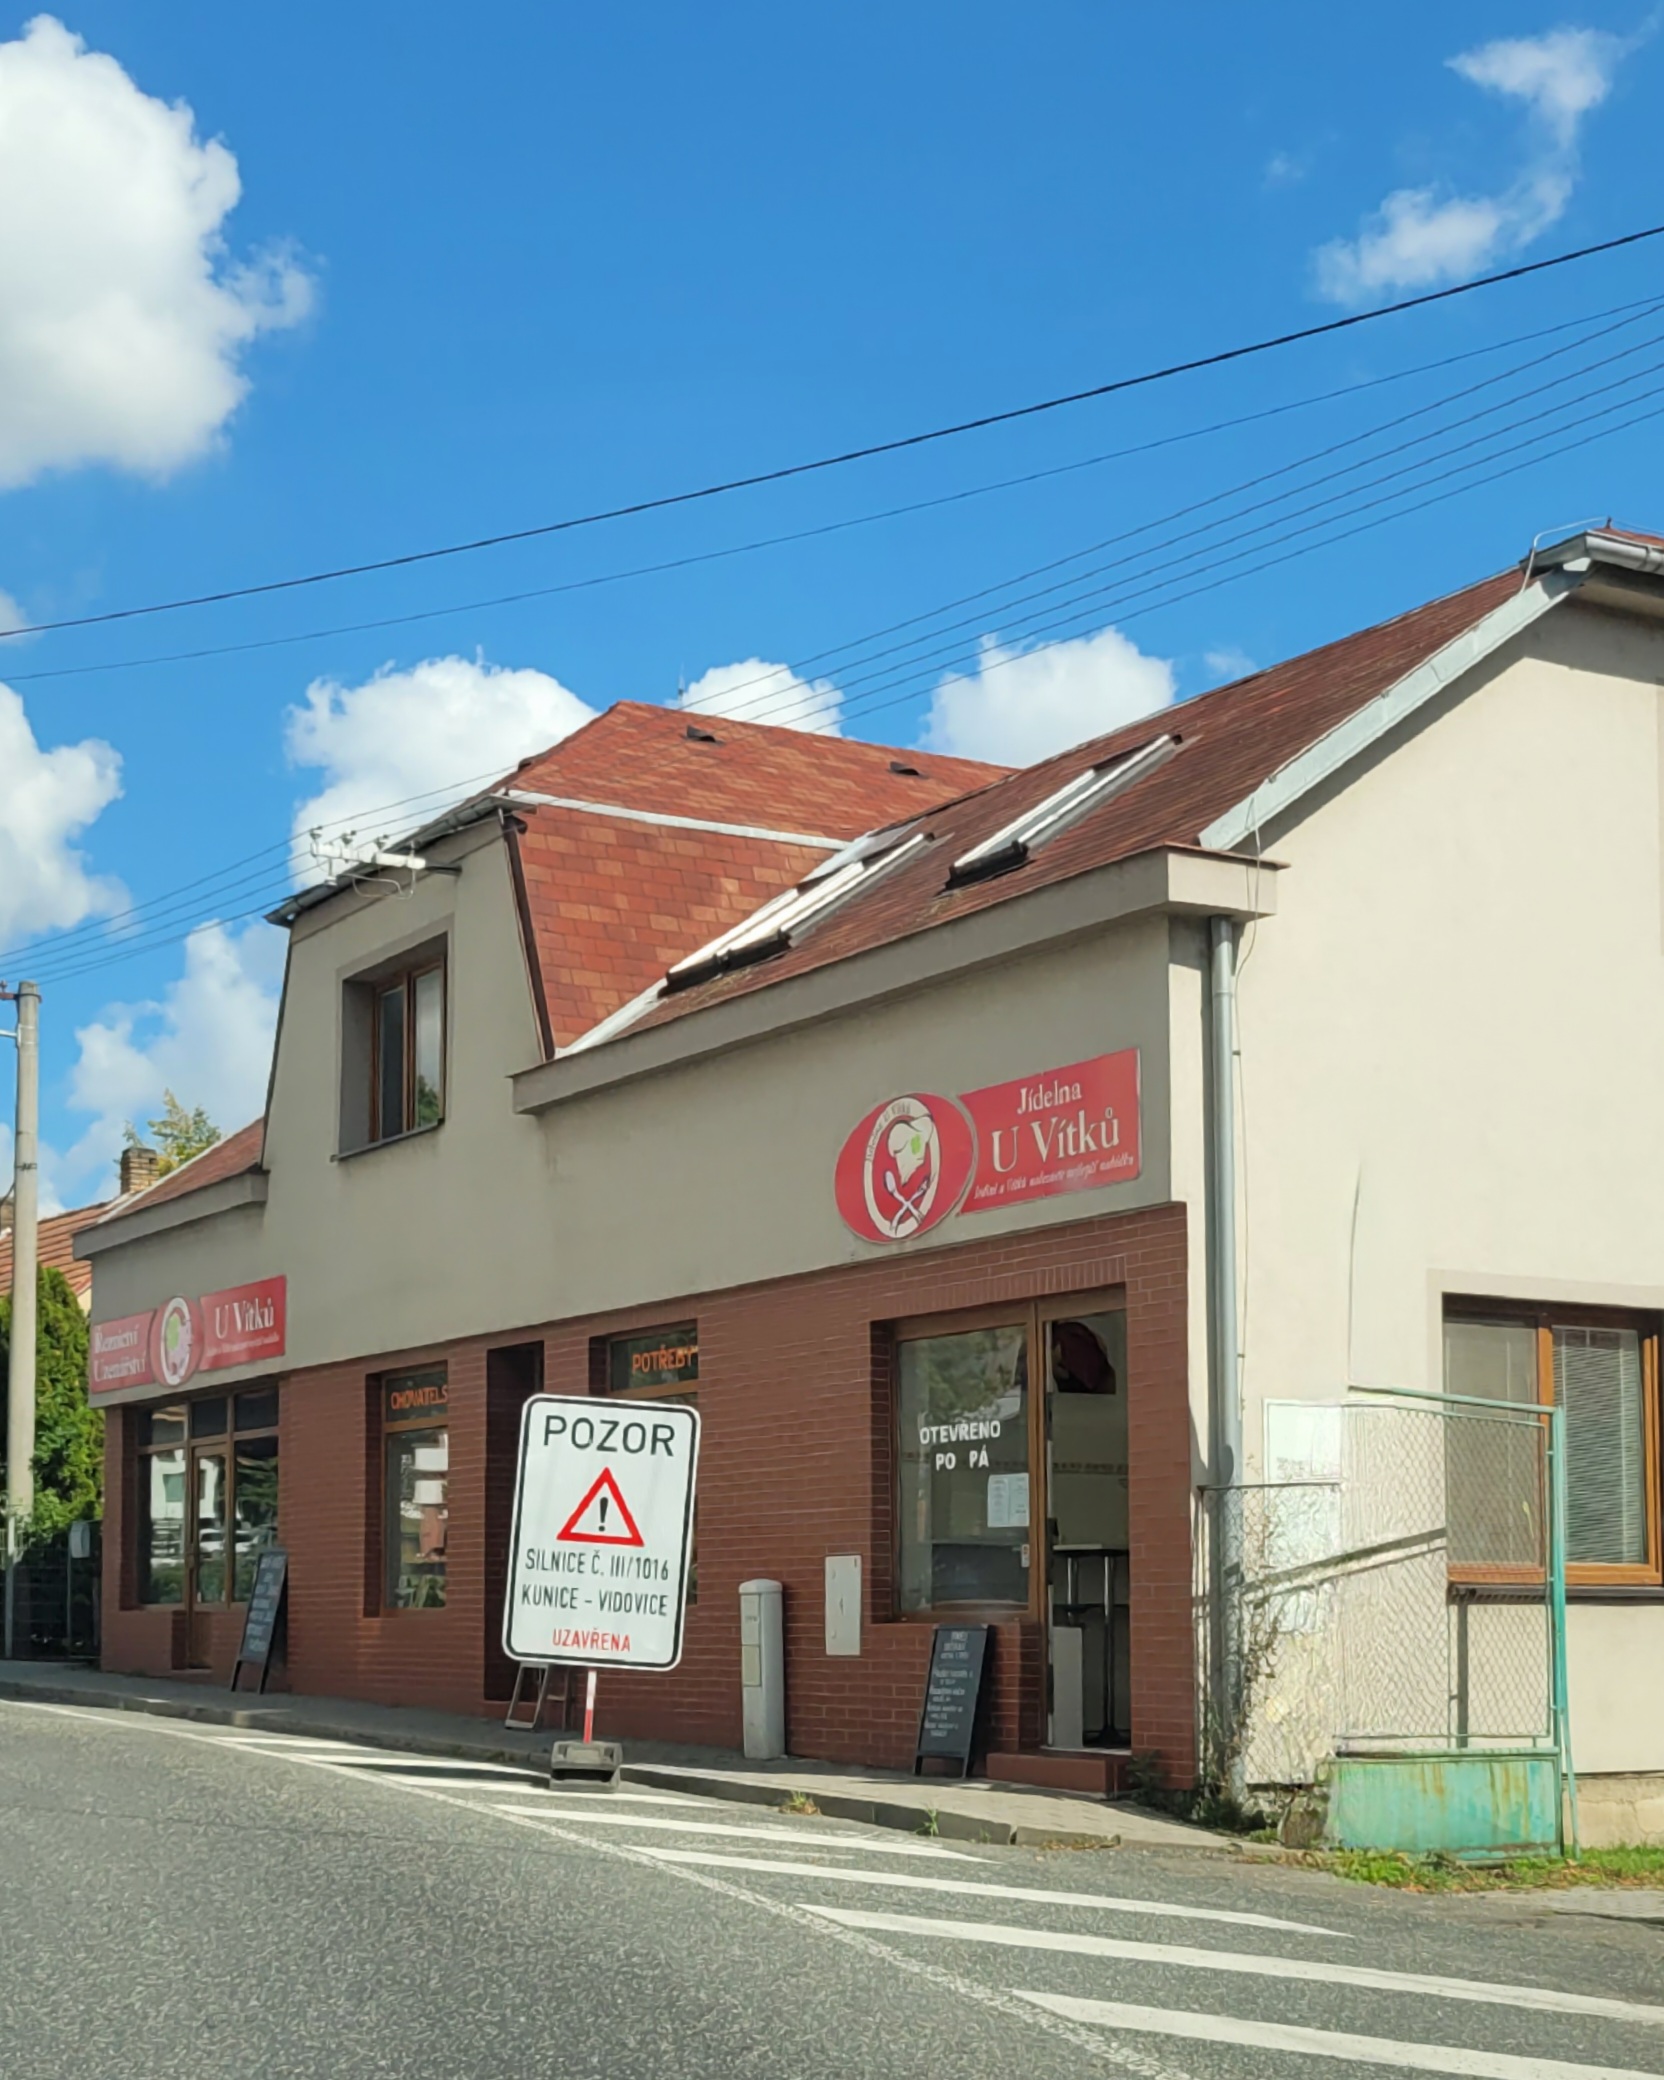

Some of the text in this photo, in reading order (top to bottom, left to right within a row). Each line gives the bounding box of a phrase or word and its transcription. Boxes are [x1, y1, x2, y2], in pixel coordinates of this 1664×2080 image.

[1017, 1079, 1083, 1114] Jídelna
[991, 1107, 1120, 1173] U Vítků
[215, 1298, 275, 1339] U Vítků
[632, 1344, 697, 1375] POTŘEBY
[543, 1415, 675, 1457] POZOR
[920, 1418, 1001, 1445] OTEVŘENO
[936, 1444, 989, 1471] PO PÁ
[525, 1548, 669, 1581] SILNICE Č. III/1016
[521, 1583, 579, 1610] KUNICE
[599, 1589, 669, 1617] VIDOVICE
[553, 1628, 631, 1652] UZAVŘENA
